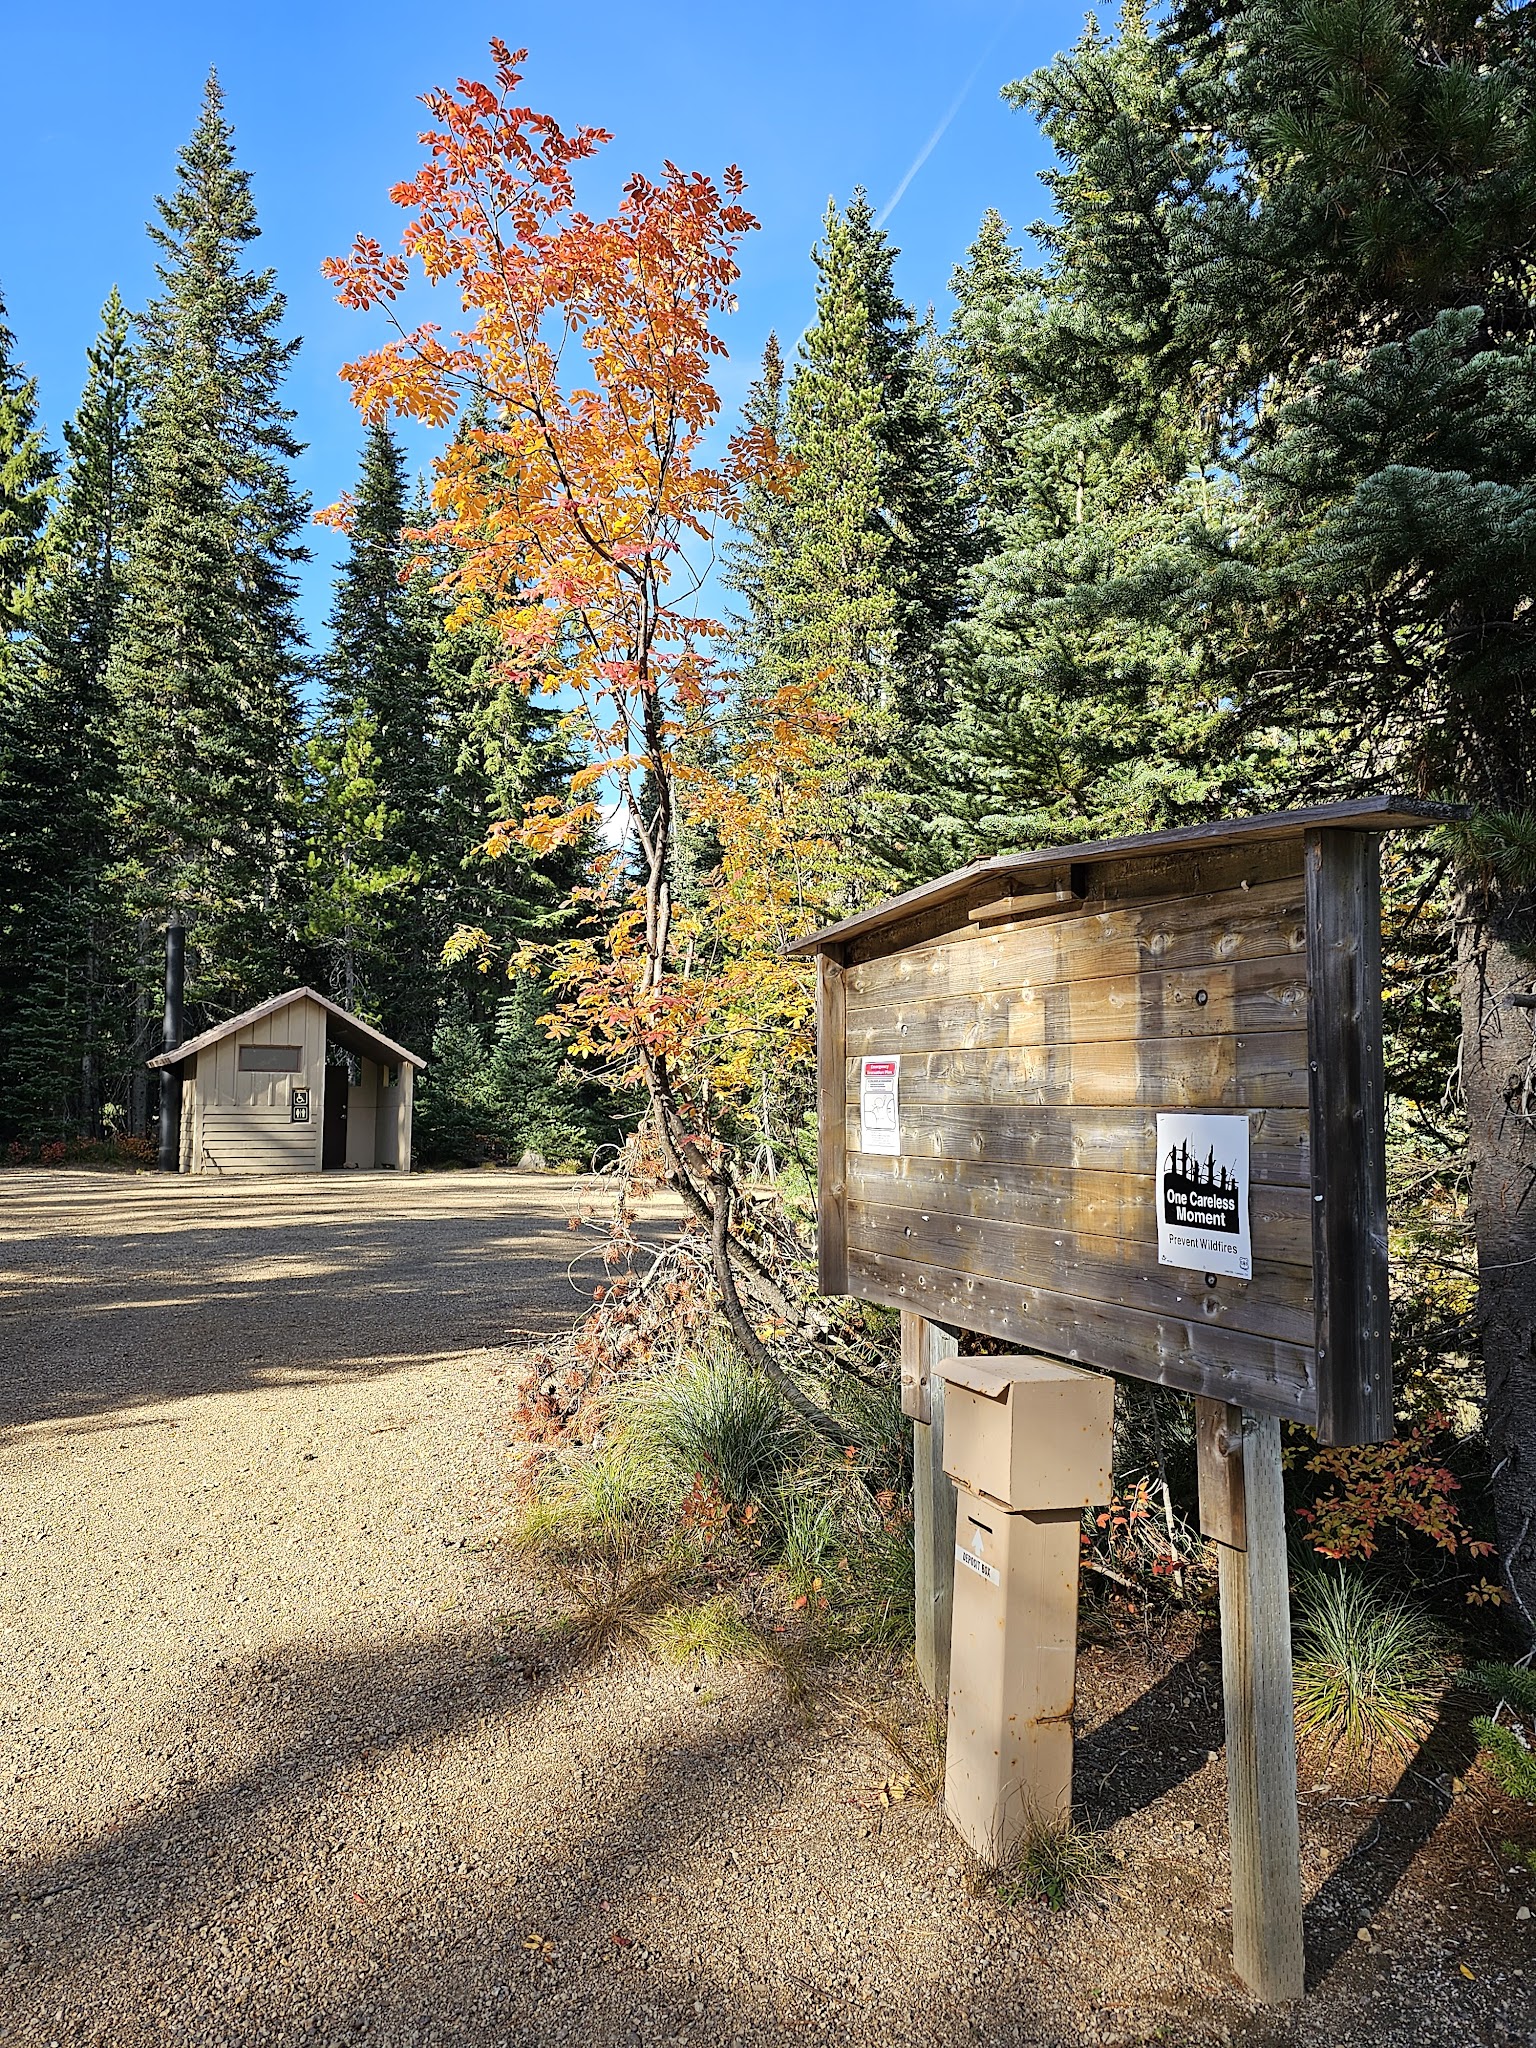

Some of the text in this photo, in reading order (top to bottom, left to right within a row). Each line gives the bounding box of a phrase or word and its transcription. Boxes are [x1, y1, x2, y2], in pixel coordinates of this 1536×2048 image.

[1166, 1189, 1235, 1210] One Careless
[1176, 1206, 1226, 1226] Moment
[1169, 1234, 1238, 1254] Prevent Wildfires
[963, 1552, 990, 1577] DEPOSIT BOX
